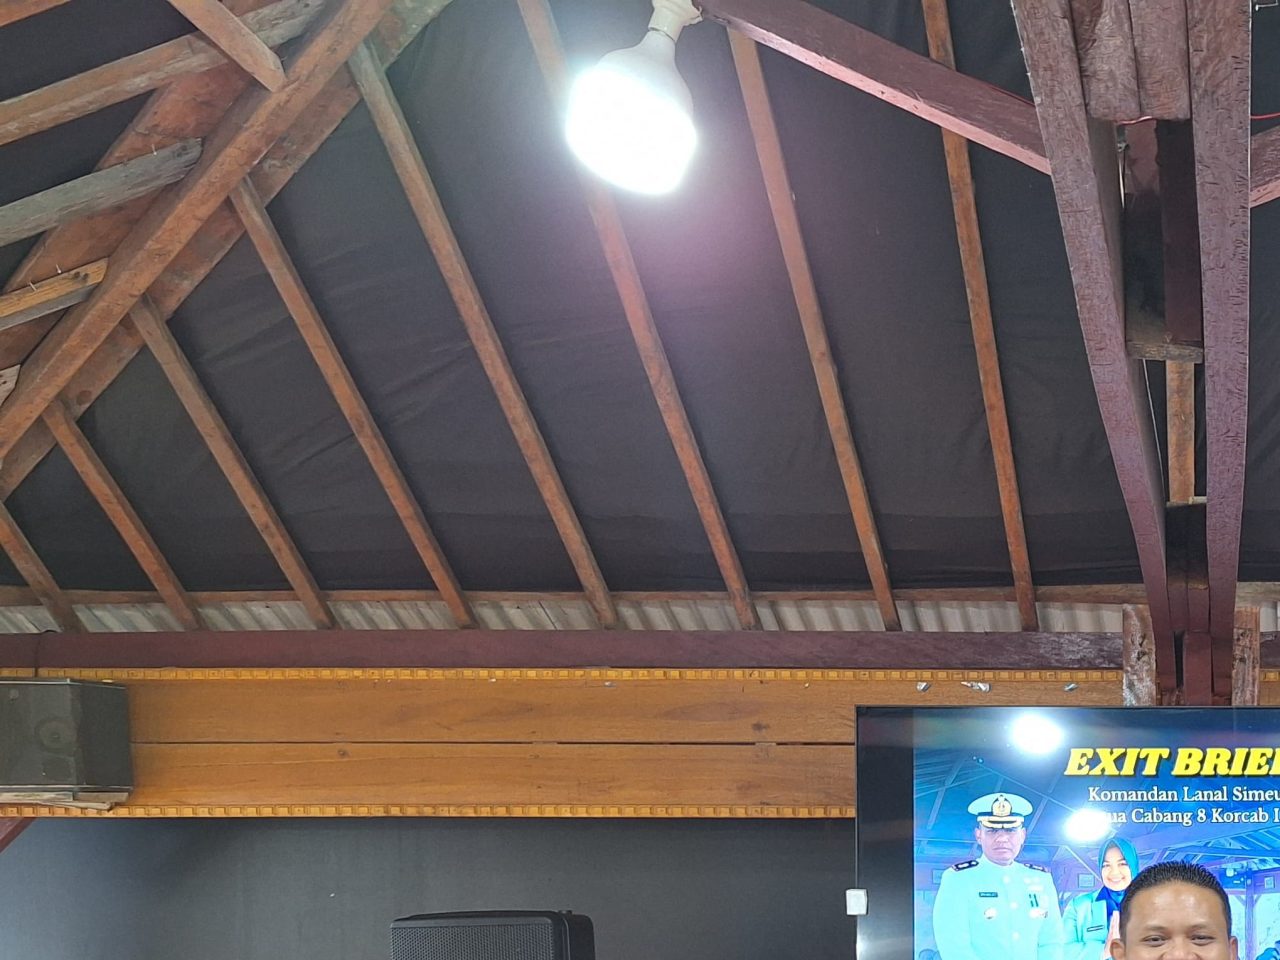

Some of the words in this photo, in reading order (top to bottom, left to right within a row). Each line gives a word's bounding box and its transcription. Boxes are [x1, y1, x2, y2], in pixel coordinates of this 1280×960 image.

[1063, 747, 1171, 777] EXIT
[1088, 786, 1178, 802] Komandan
[1183, 786, 1228, 802] Lanal
[1131, 808, 1193, 827] Cabang
[1196, 809, 1206, 823] 8
[1211, 808, 1269, 823] Korcab
[1273, 808, 1280, 823] I
